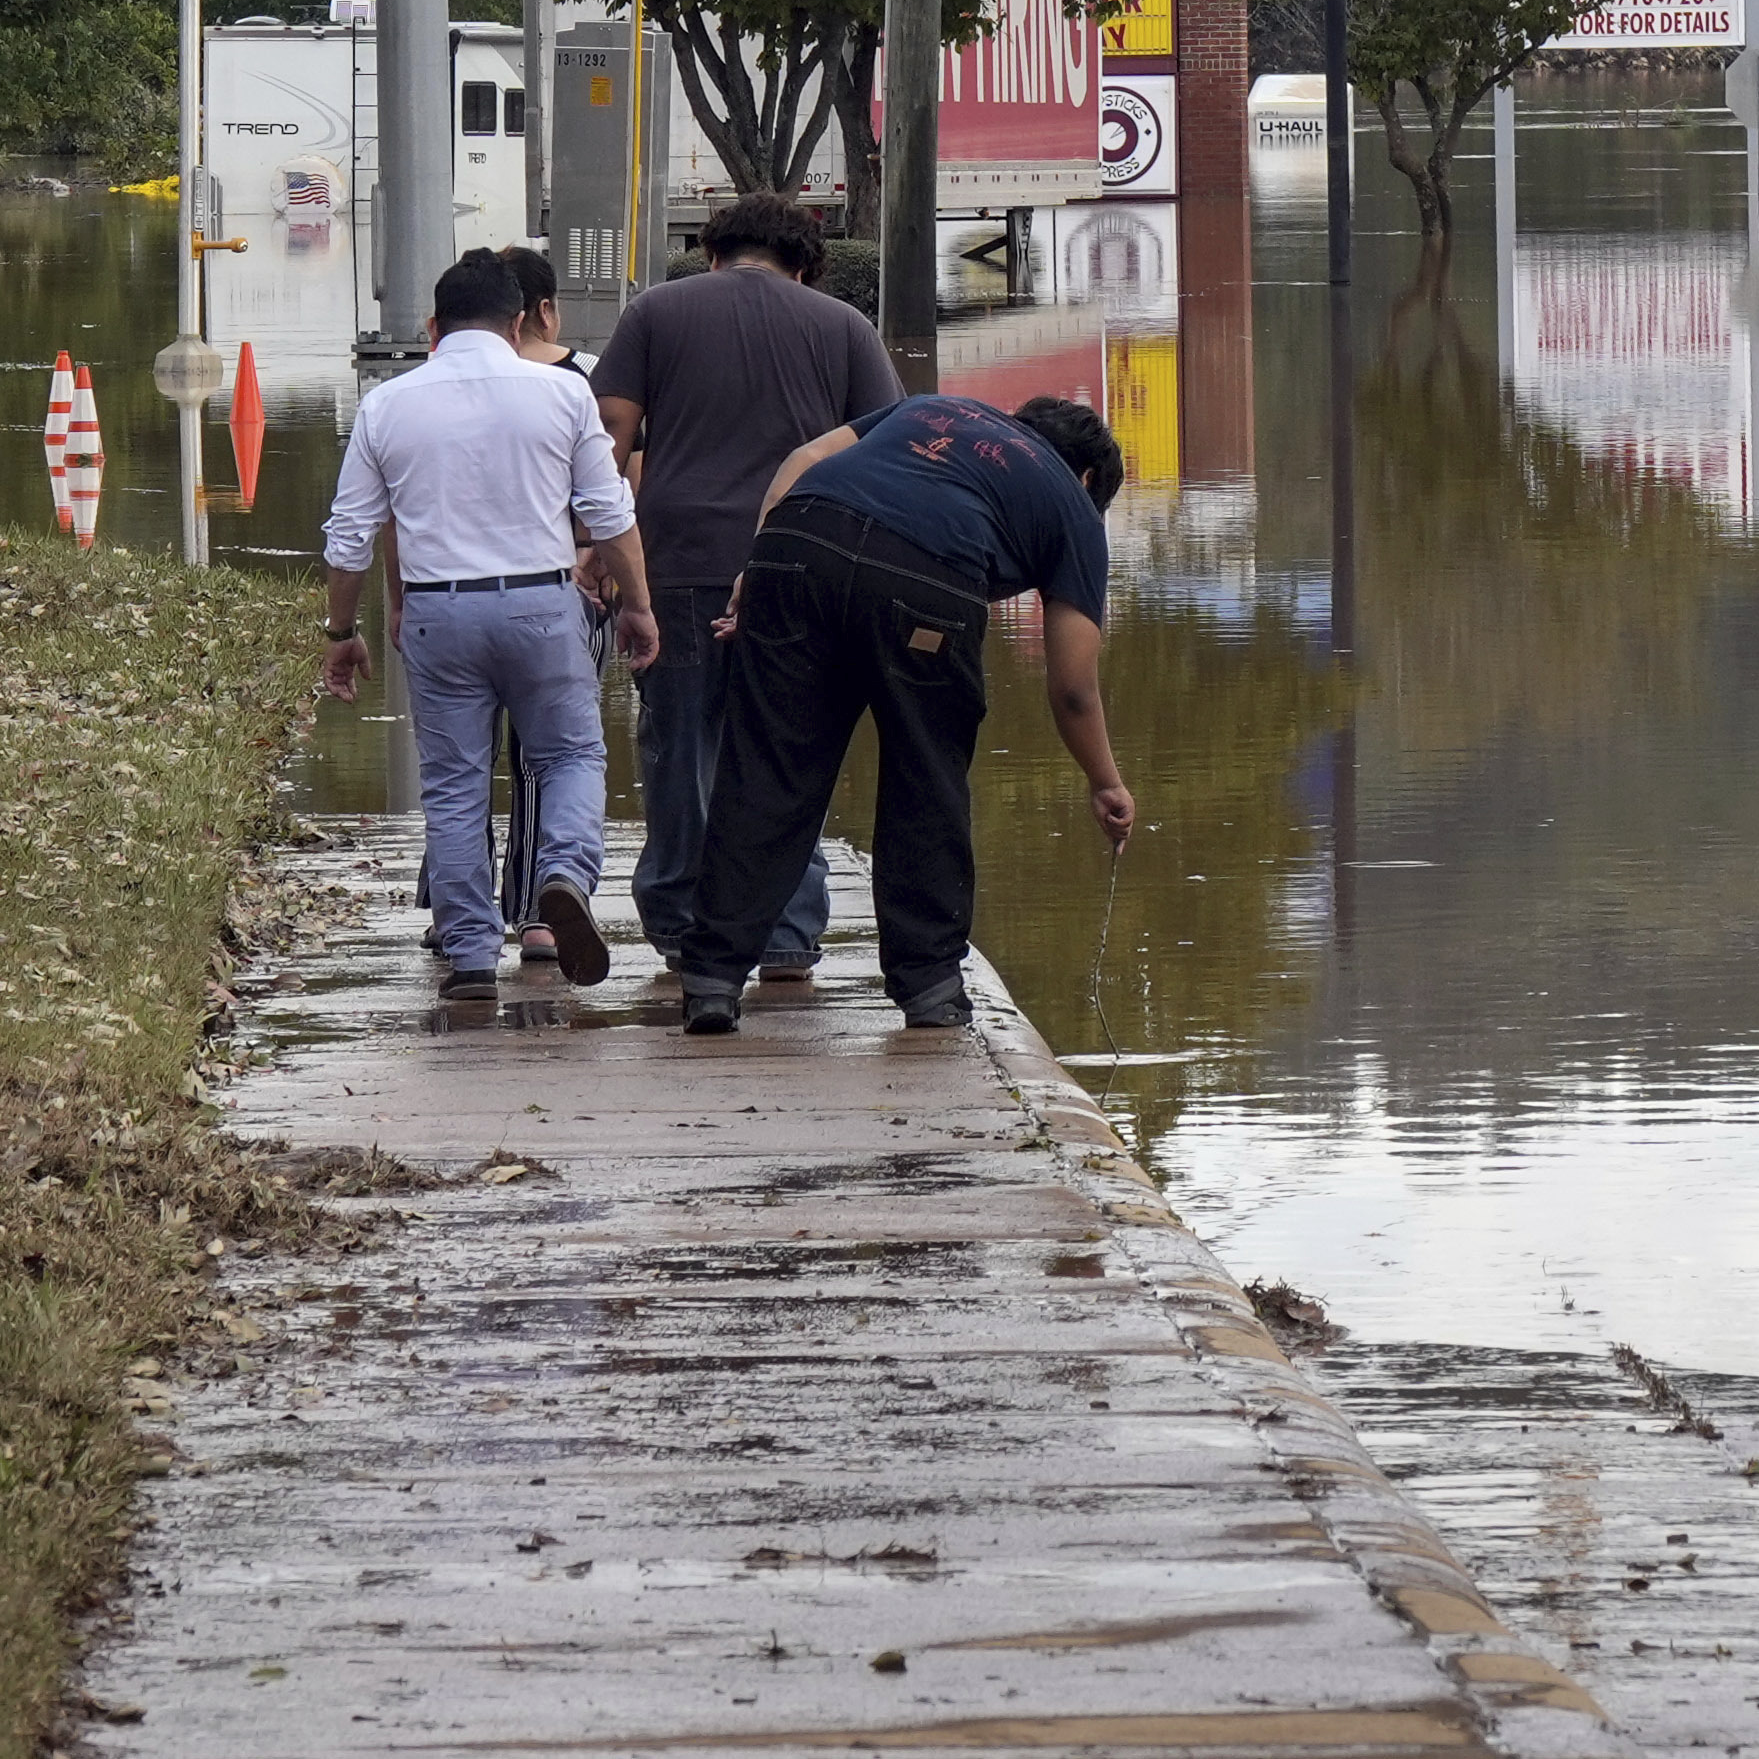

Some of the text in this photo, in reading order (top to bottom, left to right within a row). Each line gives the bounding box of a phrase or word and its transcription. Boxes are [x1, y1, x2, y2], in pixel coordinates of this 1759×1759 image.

[1571, 11, 1730, 34] TORE FOR DETAILS
[558, 53, 606, 67] 13-1292
[1100, 94, 1148, 120] STICKS
[222, 123, 299, 135] TREND
[1260, 121, 1323, 132] U-HAUL
[1100, 157, 1140, 179] PRESS
